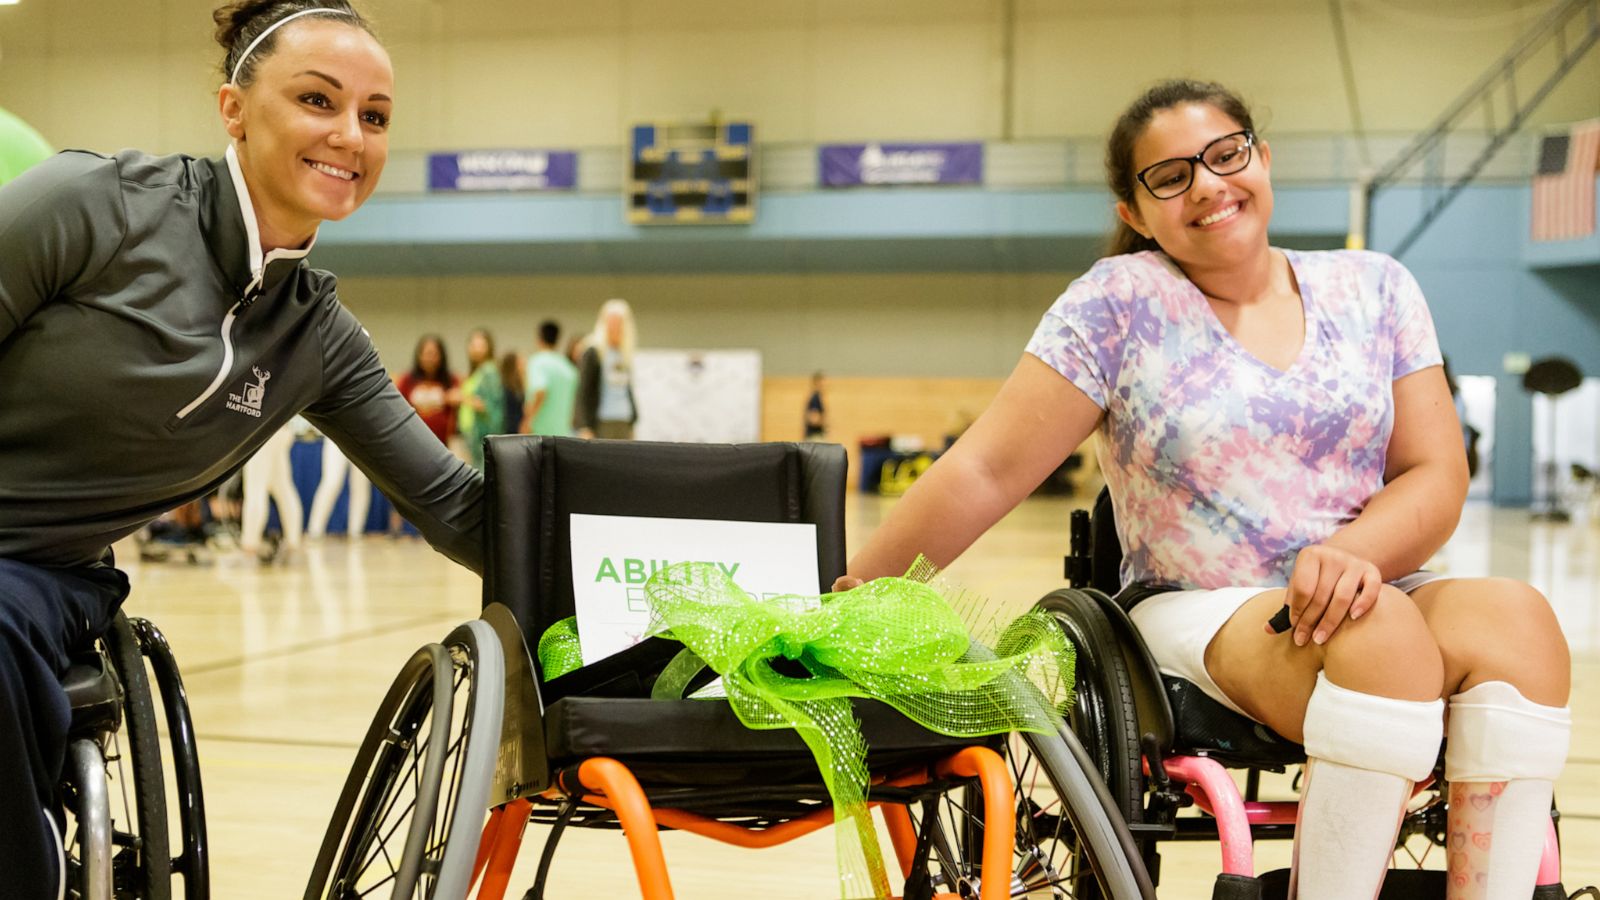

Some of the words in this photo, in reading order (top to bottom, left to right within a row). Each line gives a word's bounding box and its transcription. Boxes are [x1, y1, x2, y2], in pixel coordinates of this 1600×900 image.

[229, 393, 241, 403] THE
[226, 401, 261, 417] HARTFORD
[594, 557, 740, 586] ABILITY
